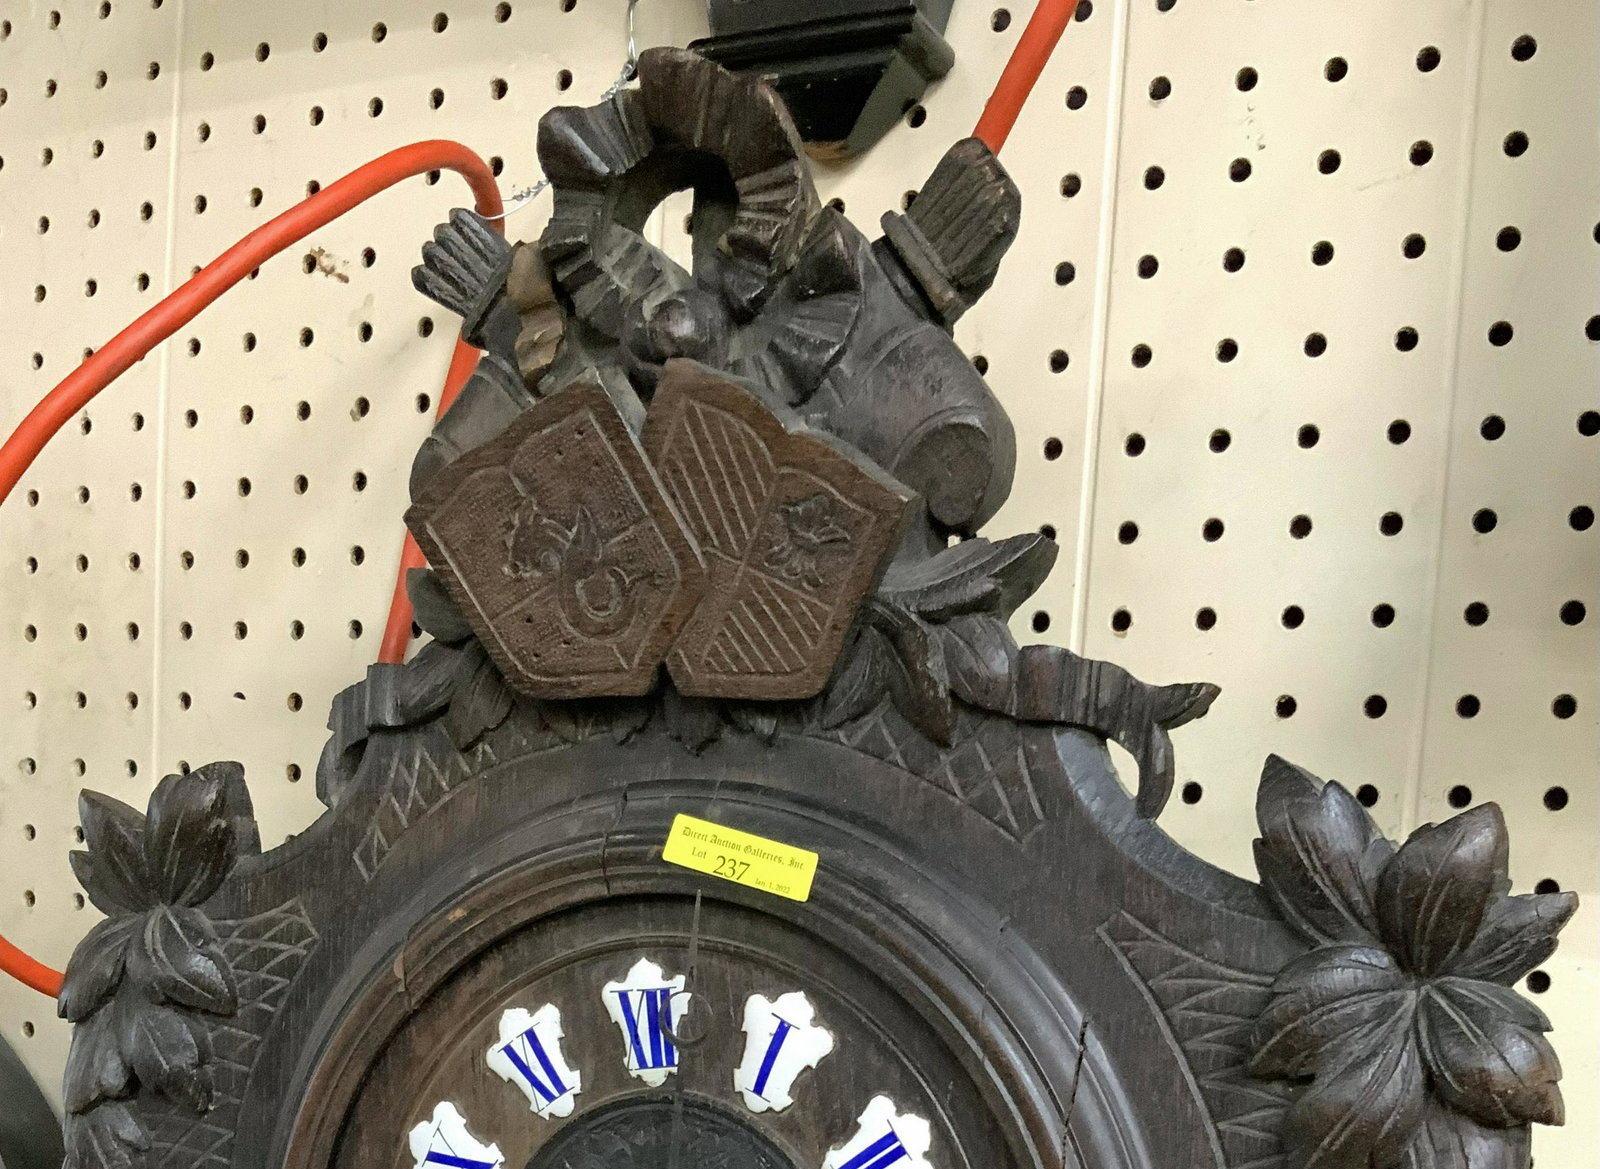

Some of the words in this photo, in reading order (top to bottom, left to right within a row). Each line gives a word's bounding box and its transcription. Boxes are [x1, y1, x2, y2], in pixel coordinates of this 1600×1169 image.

[682, 826, 708, 842] Direct
[710, 834, 741, 852] Auction
[691, 847, 707, 859] Lot
[713, 855, 751, 881] 237
[499, 1020, 576, 1114] XI
[603, 987, 677, 1072] XII
[752, 1014, 800, 1104] I
